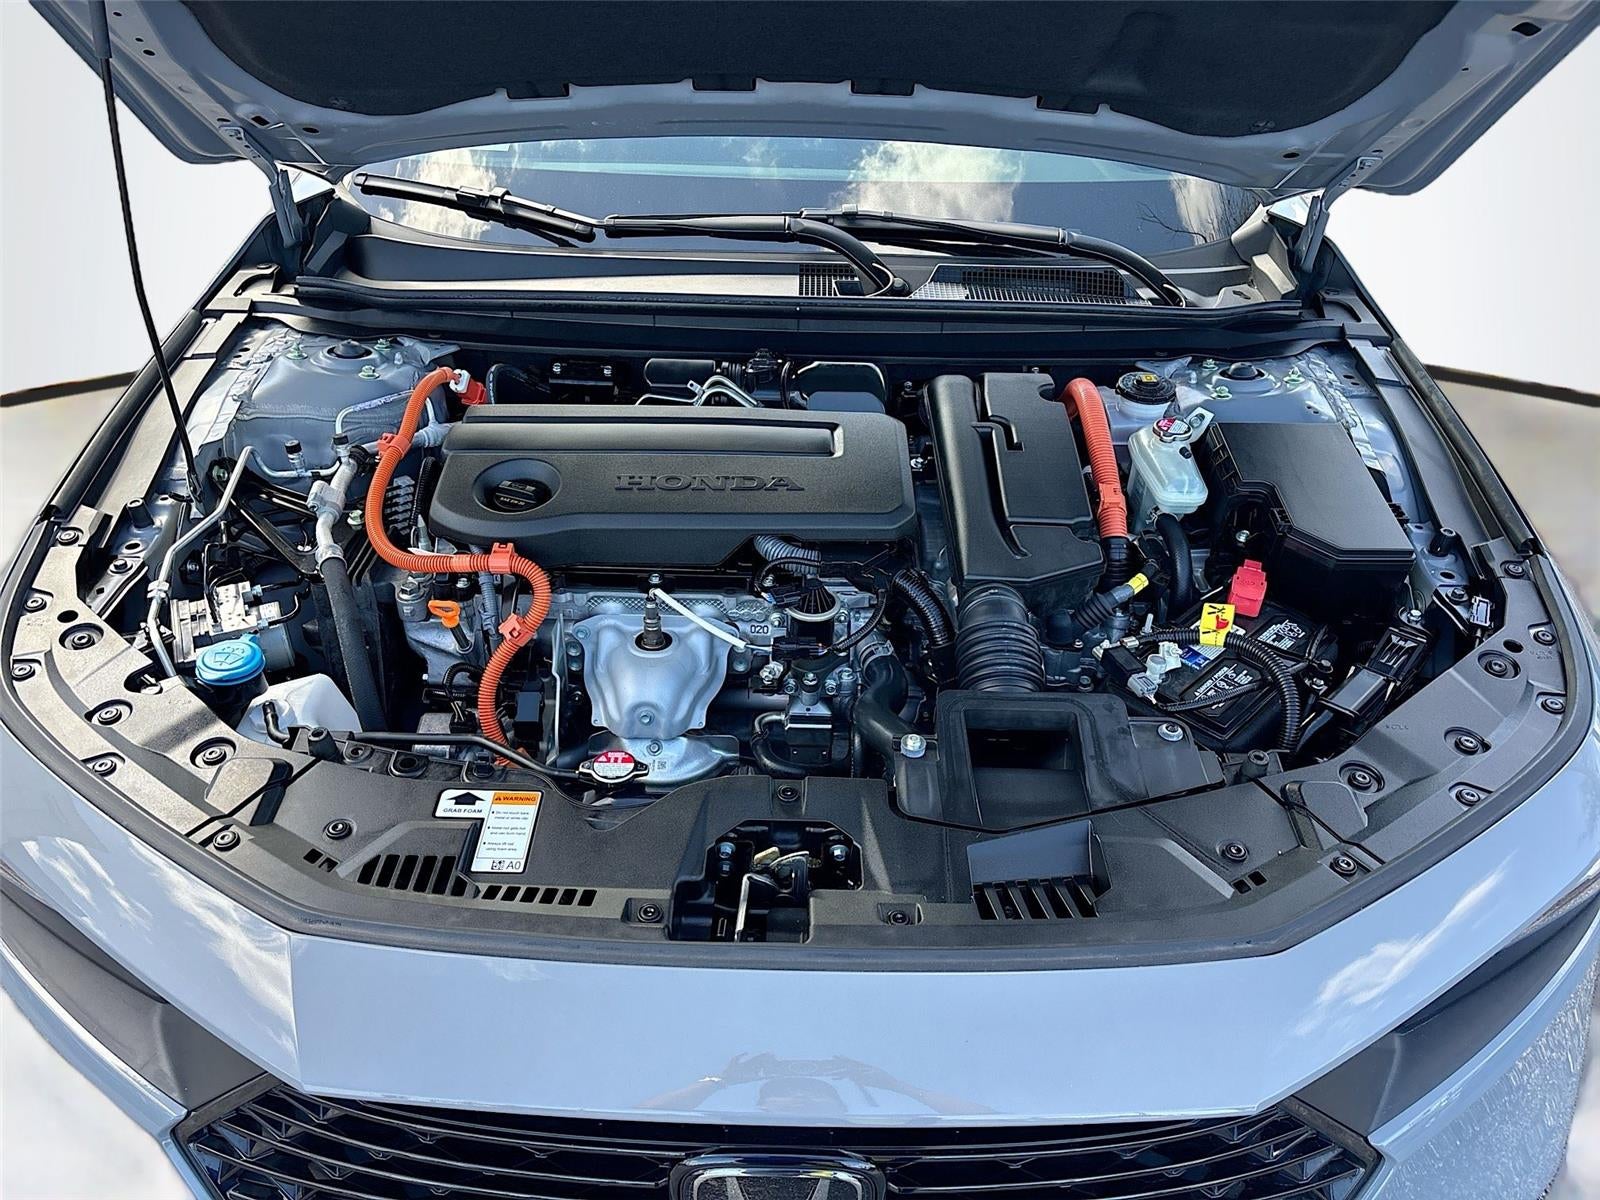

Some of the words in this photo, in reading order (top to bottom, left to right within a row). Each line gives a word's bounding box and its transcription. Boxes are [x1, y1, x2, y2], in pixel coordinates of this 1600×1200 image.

[614, 474, 805, 491] HONDA
[750, 624, 769, 635] 020
[506, 861, 521, 870] A0
